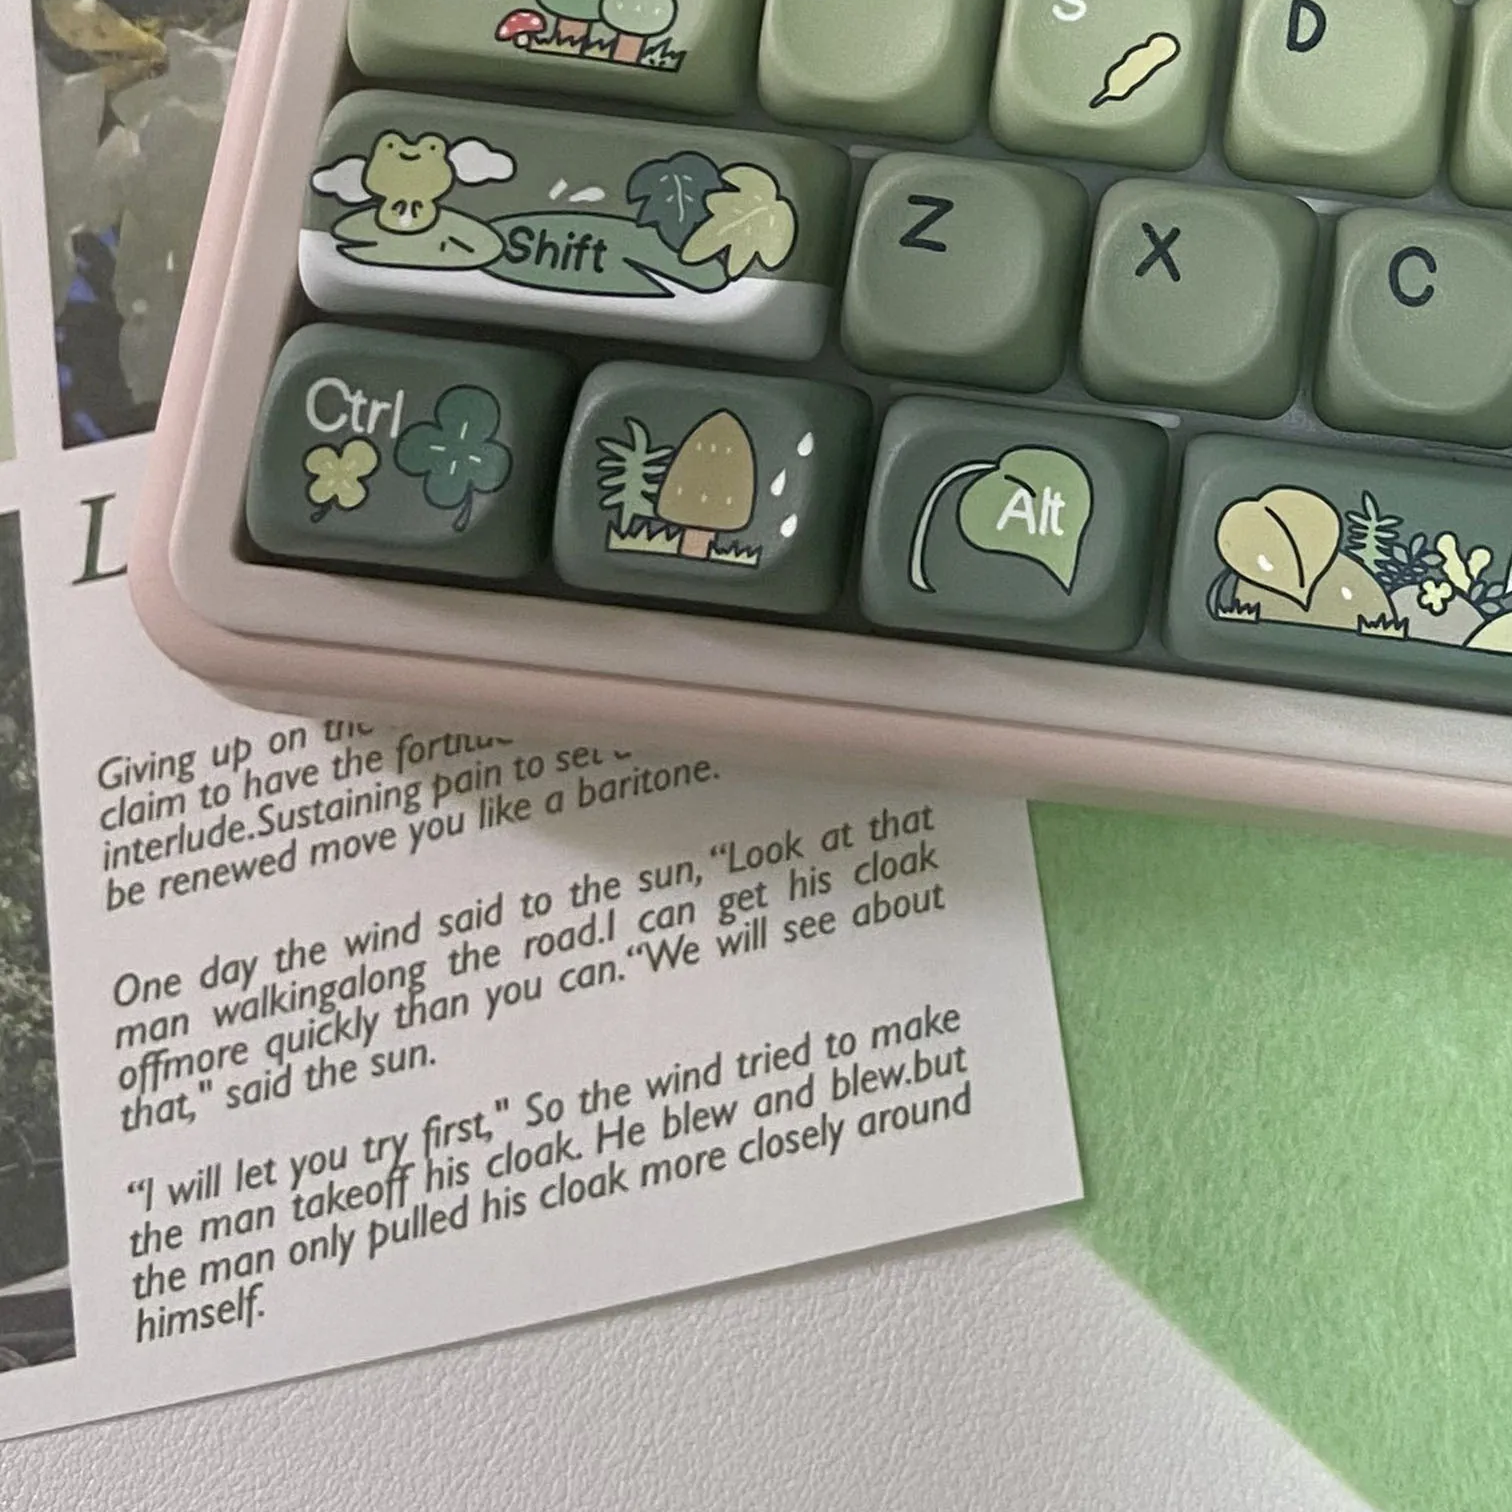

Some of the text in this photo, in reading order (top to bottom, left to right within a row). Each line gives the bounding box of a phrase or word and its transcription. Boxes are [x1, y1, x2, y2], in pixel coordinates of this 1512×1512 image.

[504, 225, 608, 275] Shift
[900, 194, 954, 252] Z
[1134, 222, 1182, 283] X
[1388, 246, 1438, 307] C
[305, 376, 405, 437] Ctrl
[996, 485, 1066, 538] Alt
[97, 750, 196, 791] Giving
[212, 736, 252, 773] up
[268, 727, 307, 755] on
[99, 790, 186, 832] claim
[198, 783, 231, 810] to
[243, 764, 319, 801] have
[331, 746, 383, 782] the
[432, 765, 502, 810] pain
[513, 755, 545, 782] to
[106, 760, 720, 912] be renewed move you like a baritone.
[113, 972, 182, 1008] One
[199, 954, 258, 992] day
[274, 937, 327, 974] the
[344, 910, 421, 958] wind
[438, 891, 503, 938] said
[520, 892, 553, 920] to
[569, 873, 621, 909] the
[638, 861, 703, 893] sun,
[820, 823, 854, 853] at
[868, 805, 935, 842] that
[115, 1013, 189, 1050] man
[213, 960, 427, 1028] walkingalong
[448, 940, 501, 977] the
[637, 901, 695, 934] can
[718, 881, 769, 927] get
[789, 866, 832, 902] his
[854, 839, 939, 886] cloak
[118, 1042, 249, 1095] offmore
[265, 1005, 380, 1067] quickly
[394, 988, 469, 1030] than
[485, 976, 542, 1021] you
[716, 915, 767, 958] will
[783, 911, 836, 944] see
[852, 884, 946, 928] about
[167, 1163, 221, 1206] will
[236, 1158, 278, 1192] let
[290, 1145, 347, 1192] you
[362, 1132, 409, 1172] try
[525, 1091, 564, 1128] So
[578, 1079, 631, 1116] the
[645, 1051, 722, 1100] wind
[736, 1031, 811, 1080] tried
[825, 1032, 857, 1060] to
[871, 1004, 961, 1050] make
[226, 1062, 292, 1110] said
[304, 1055, 358, 1092] the
[370, 1044, 436, 1078] sun.
[129, 1220, 183, 1258] the
[199, 1205, 275, 1243] man
[291, 1161, 416, 1222] takeoff
[424, 1154, 470, 1193] his
[486, 1129, 583, 1179] cloak.
[596, 1115, 646, 1155] He
[662, 1100, 738, 1141] blew
[753, 1072, 814, 1118] and
[132, 1080, 971, 1301] the man only pulled his cloak more closely around
[136, 1281, 265, 1344] himself.
